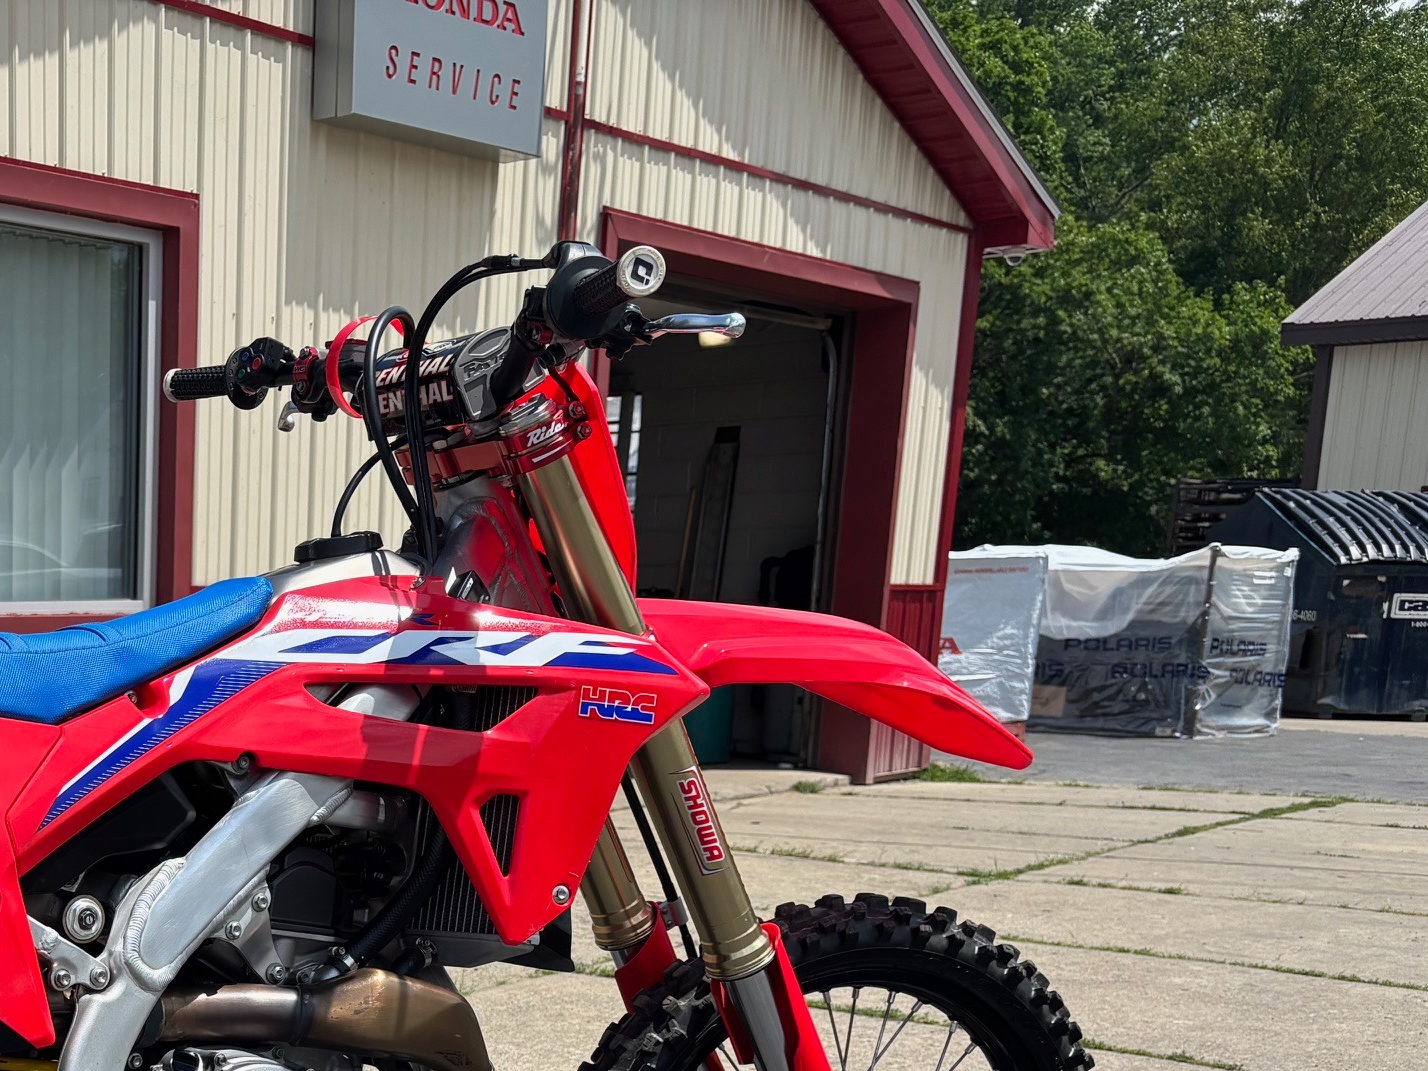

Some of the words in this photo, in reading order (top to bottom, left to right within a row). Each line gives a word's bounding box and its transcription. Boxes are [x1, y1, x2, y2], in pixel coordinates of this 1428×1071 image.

[385, 44, 521, 110] SERVICE
[240, 629, 654, 668] CRF
[1064, 637, 1173, 651] POLARIS
[1209, 637, 1268, 656] POLARIS
[1110, 662, 1211, 680] POLARIS
[1229, 668, 1288, 688] POLARIS
[578, 685, 658, 724] HRC
[677, 777, 725, 864] SHOWA
